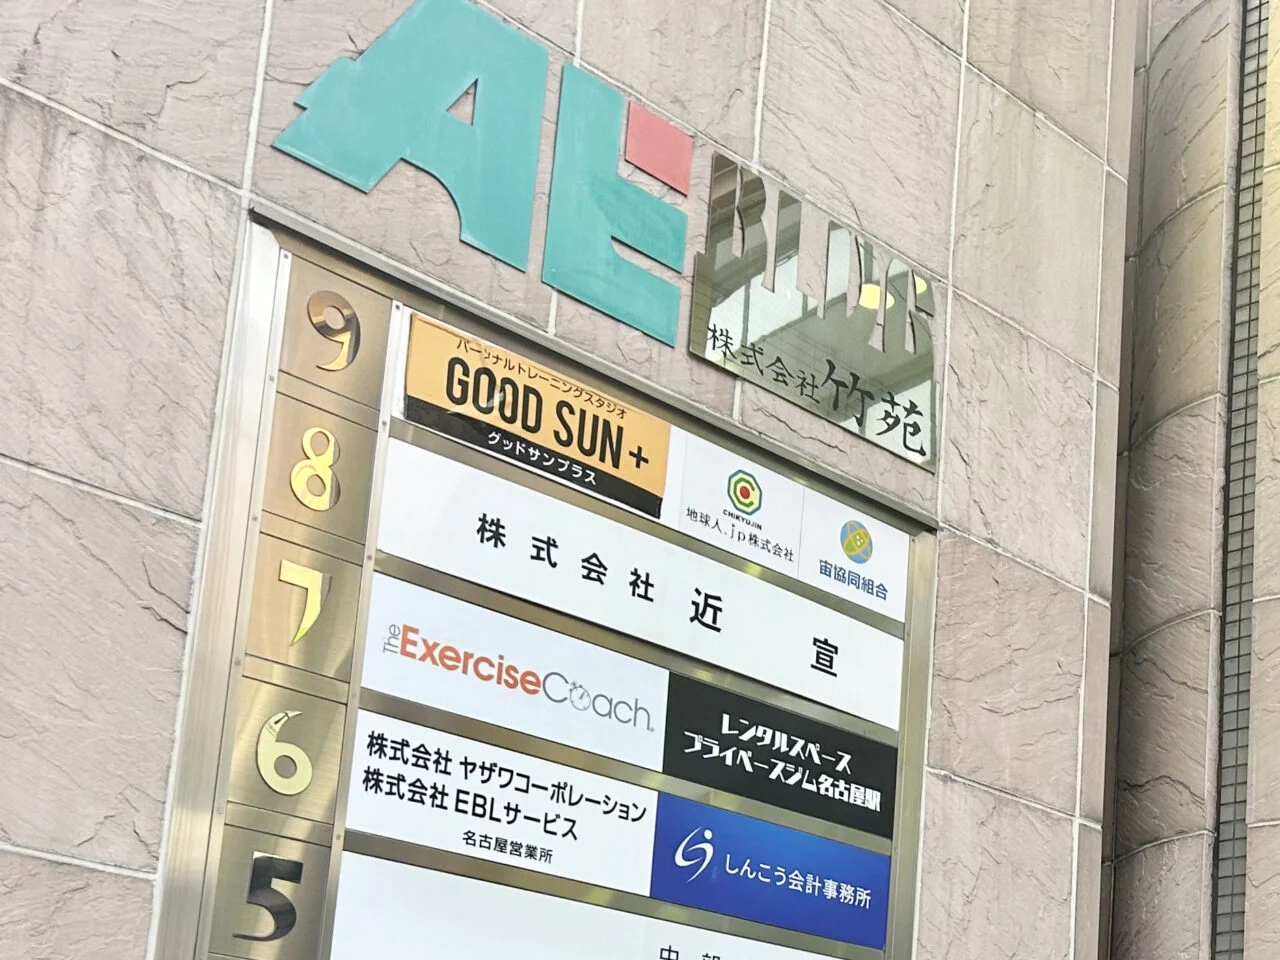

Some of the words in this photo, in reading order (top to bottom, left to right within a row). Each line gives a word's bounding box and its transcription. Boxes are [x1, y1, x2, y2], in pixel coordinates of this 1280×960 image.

[306, 289, 361, 372] 9
[445, 356, 543, 434] GOOD
[456, 338, 628, 420] パーソナルトレーニングスタジオ
[706, 323, 927, 457] 株式会社竹苑
[290, 427, 341, 511] 8
[487, 431, 597, 485] グッドサンプラス
[722, 508, 762, 531] CHIKYUJIN
[279, 559, 332, 647] 7
[818, 559, 889, 601] 宙協同組合
[383, 624, 401, 654] The
[256, 710, 313, 796] 6
[366, 730, 453, 776] 株式会社
[459, 756, 648, 823] ヤザワコーポレーション
[721, 712, 852, 775] レンタルスペース
[362, 766, 449, 811] 株式会社
[454, 789, 579, 841] EBLサービス
[461, 829, 554, 864] 名古屋営業所
[723, 851, 873, 909] しんこう会計事務所
[232, 850, 303, 942] 5
